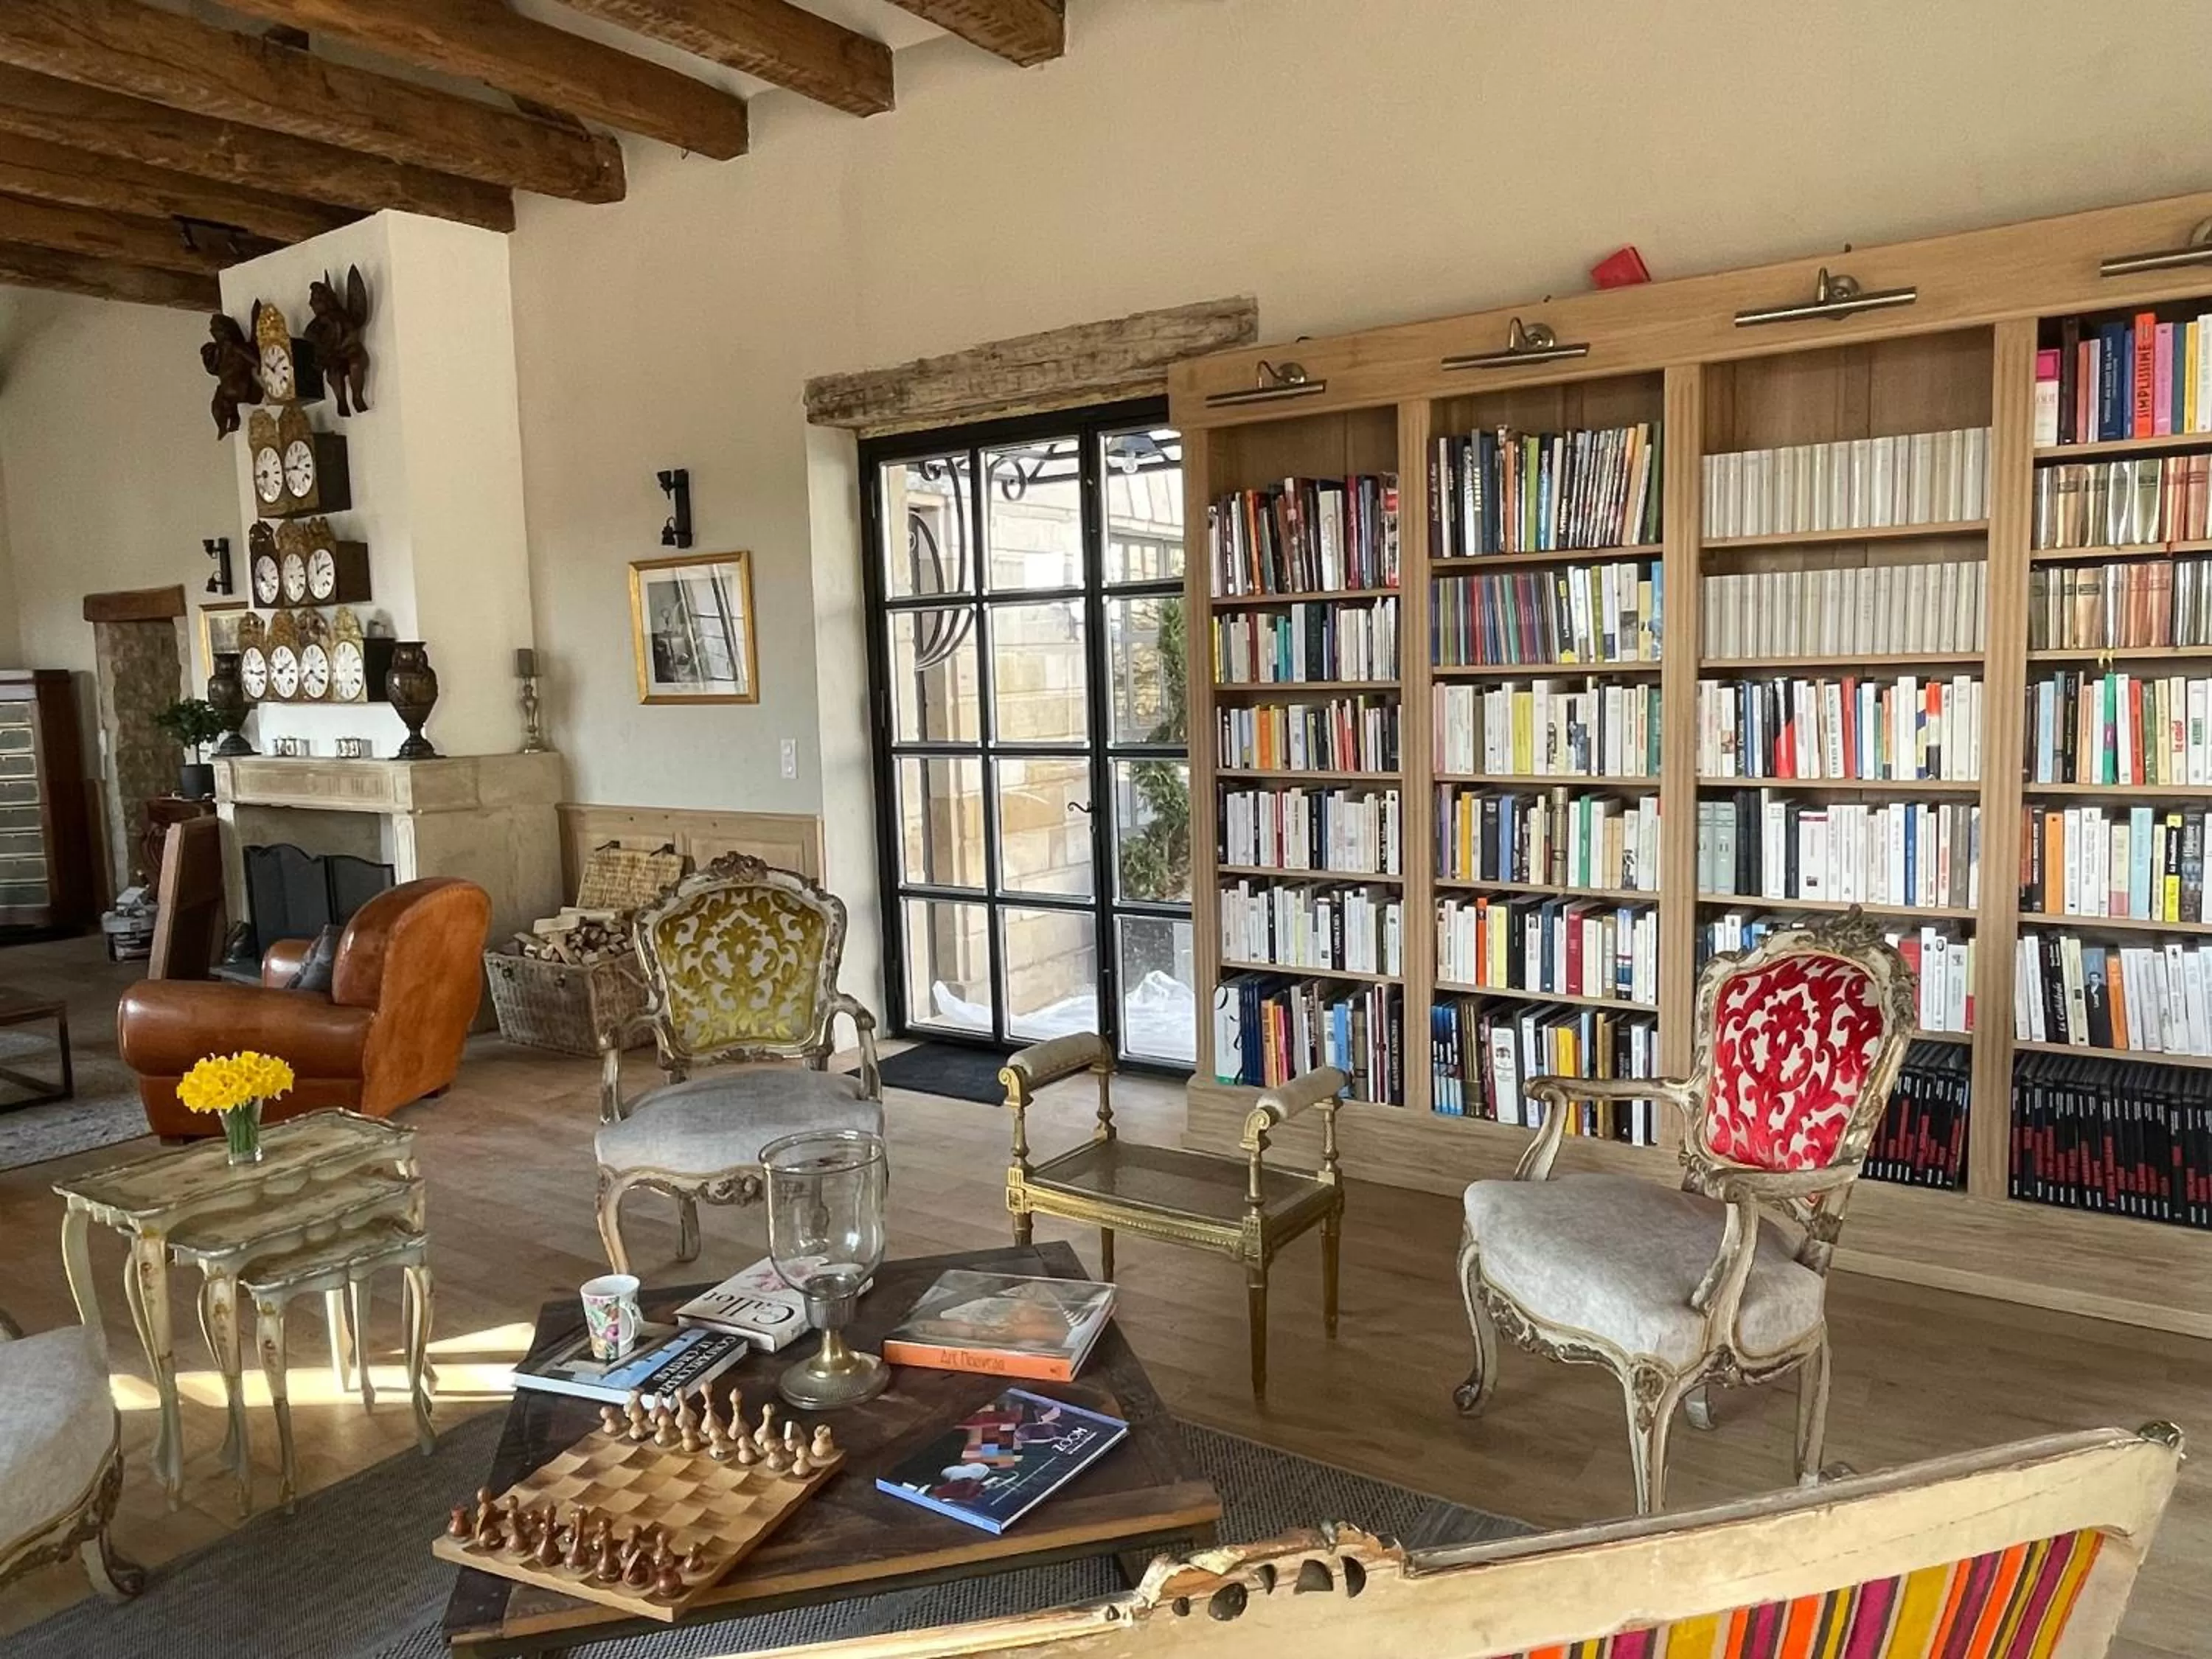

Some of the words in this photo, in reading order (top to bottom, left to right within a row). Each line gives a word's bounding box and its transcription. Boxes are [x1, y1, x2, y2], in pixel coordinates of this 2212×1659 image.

[2138, 345, 2151, 418] SIMPLISSIME
[703, 1291, 795, 1324] Callot
[940, 1349, 959, 1366] Art
